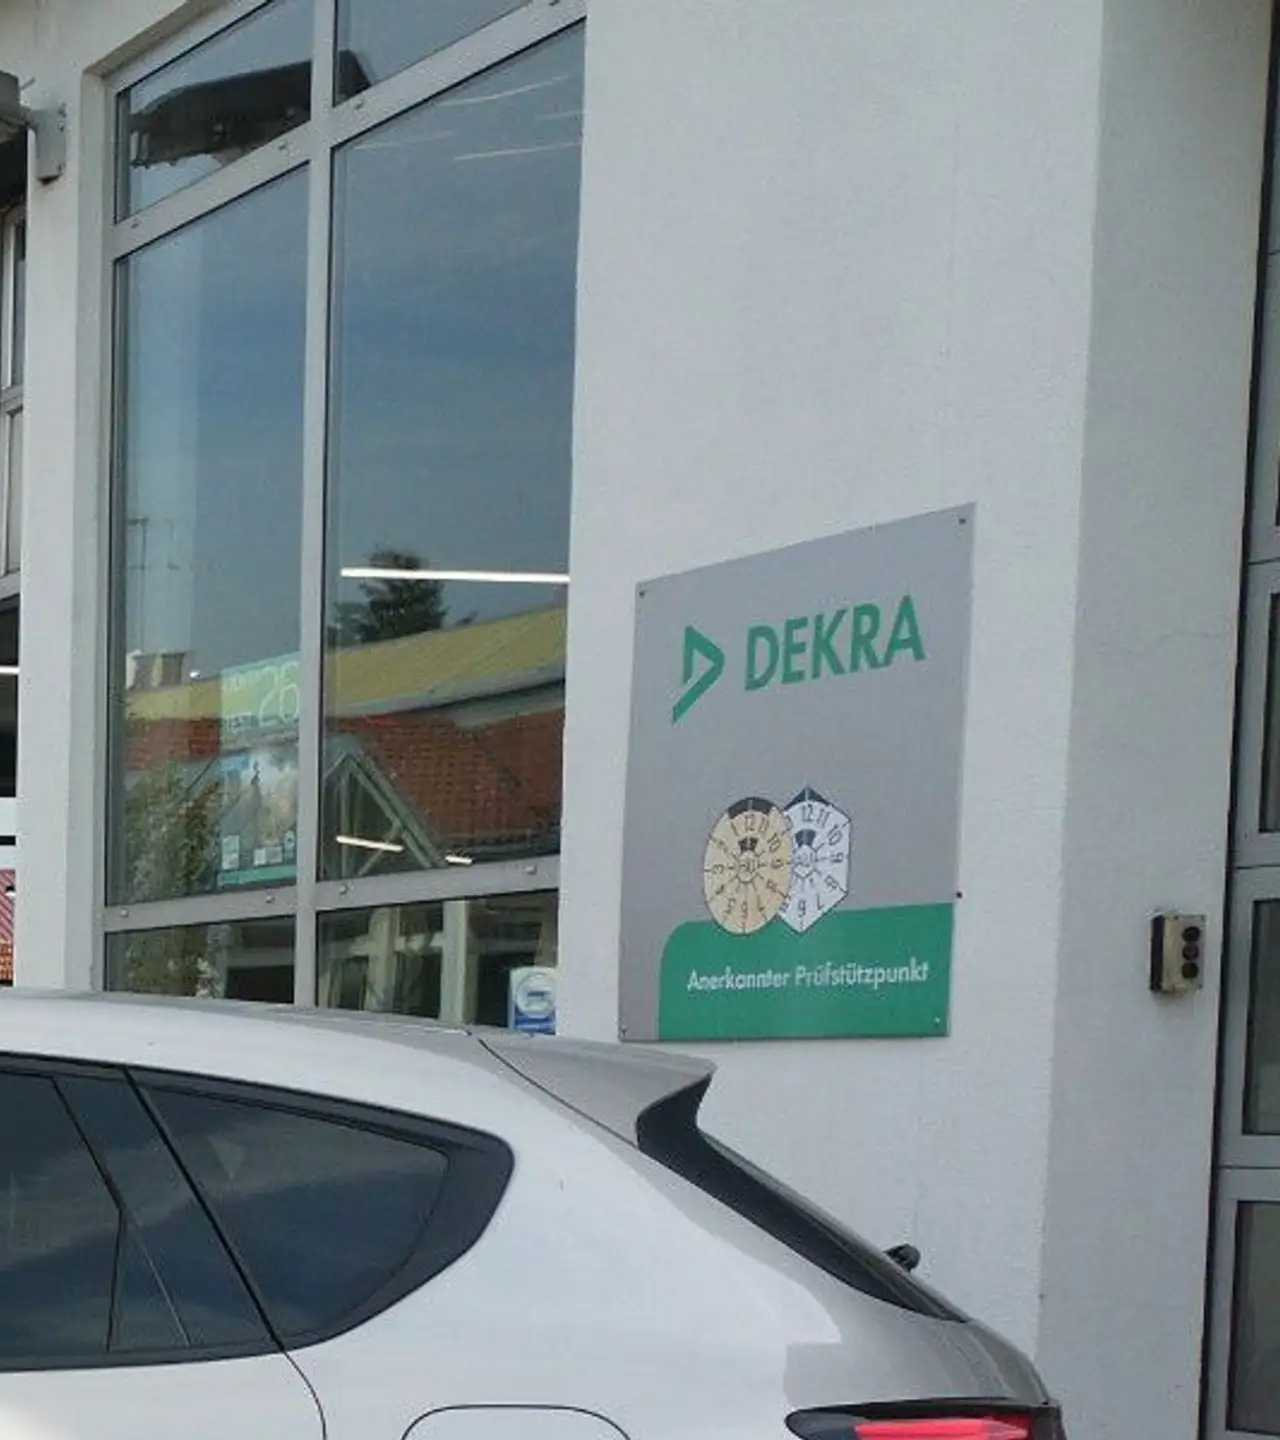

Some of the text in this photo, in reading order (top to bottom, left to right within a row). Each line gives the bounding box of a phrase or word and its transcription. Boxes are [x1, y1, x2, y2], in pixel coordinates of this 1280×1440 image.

[744, 595, 927, 691] DEKRA
[687, 956, 930, 991] Anerkannter Prüfstützpunkt
